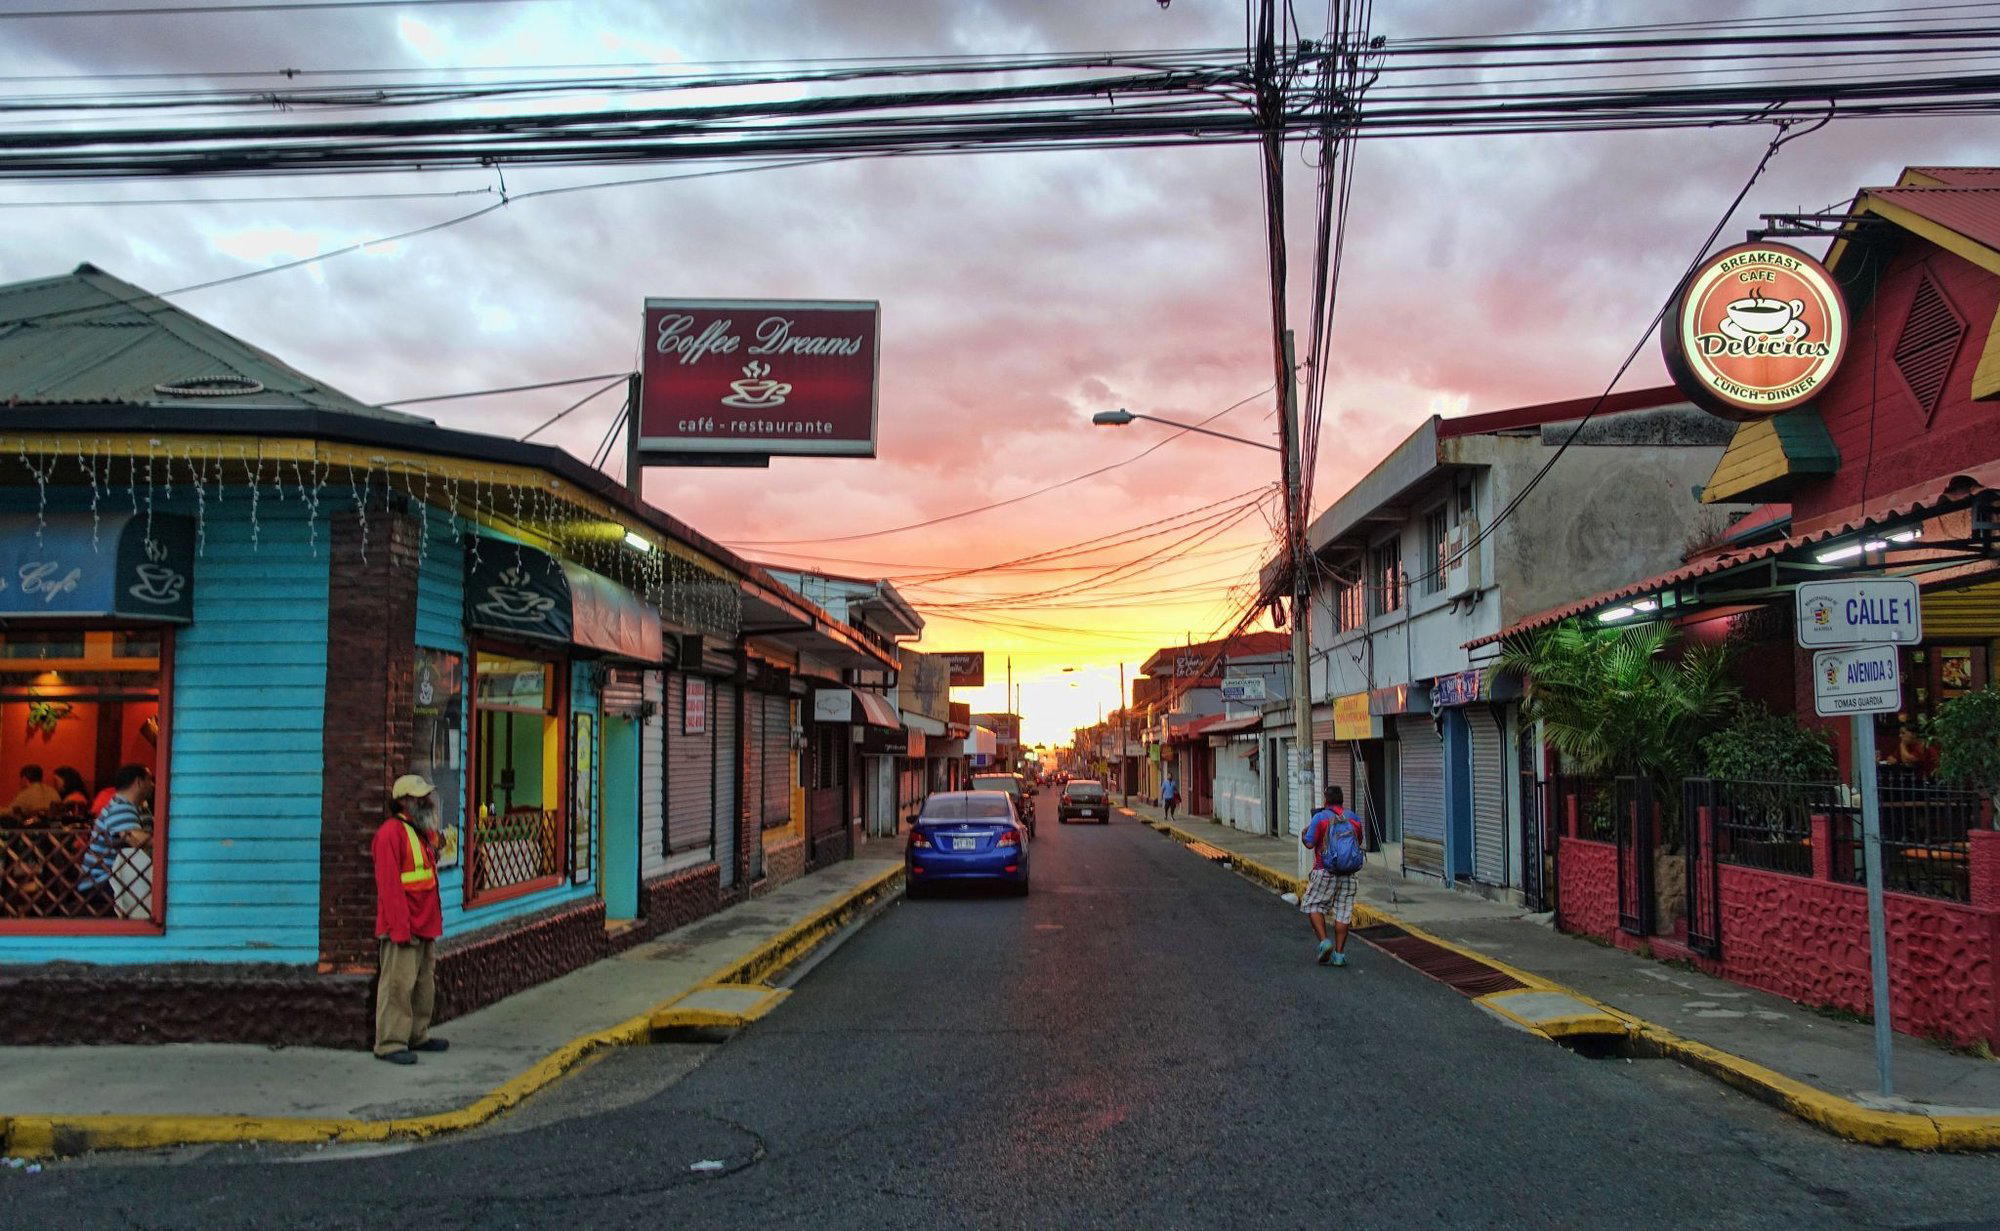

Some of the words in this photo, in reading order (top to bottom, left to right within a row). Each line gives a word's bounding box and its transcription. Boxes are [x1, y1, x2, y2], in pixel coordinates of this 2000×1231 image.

[1720, 253, 1802, 273] BREAKFAST
[1739, 271, 1775, 282] CAFE
[656, 314, 741, 365] Coffee
[748, 316, 863, 356] Dreams
[1697, 334, 1830, 356] Delicias
[678, 417, 714, 432] café
[731, 418, 833, 433] restaurante
[1846, 598, 1899, 625] CALLE
[1904, 598, 1911, 624] 1
[1847, 660, 1886, 684] AVENIDA
[1887, 659, 1894, 680] 3
[1834, 698, 1857, 709] TOMAS
[1858, 696, 1883, 707] GUARDIA
